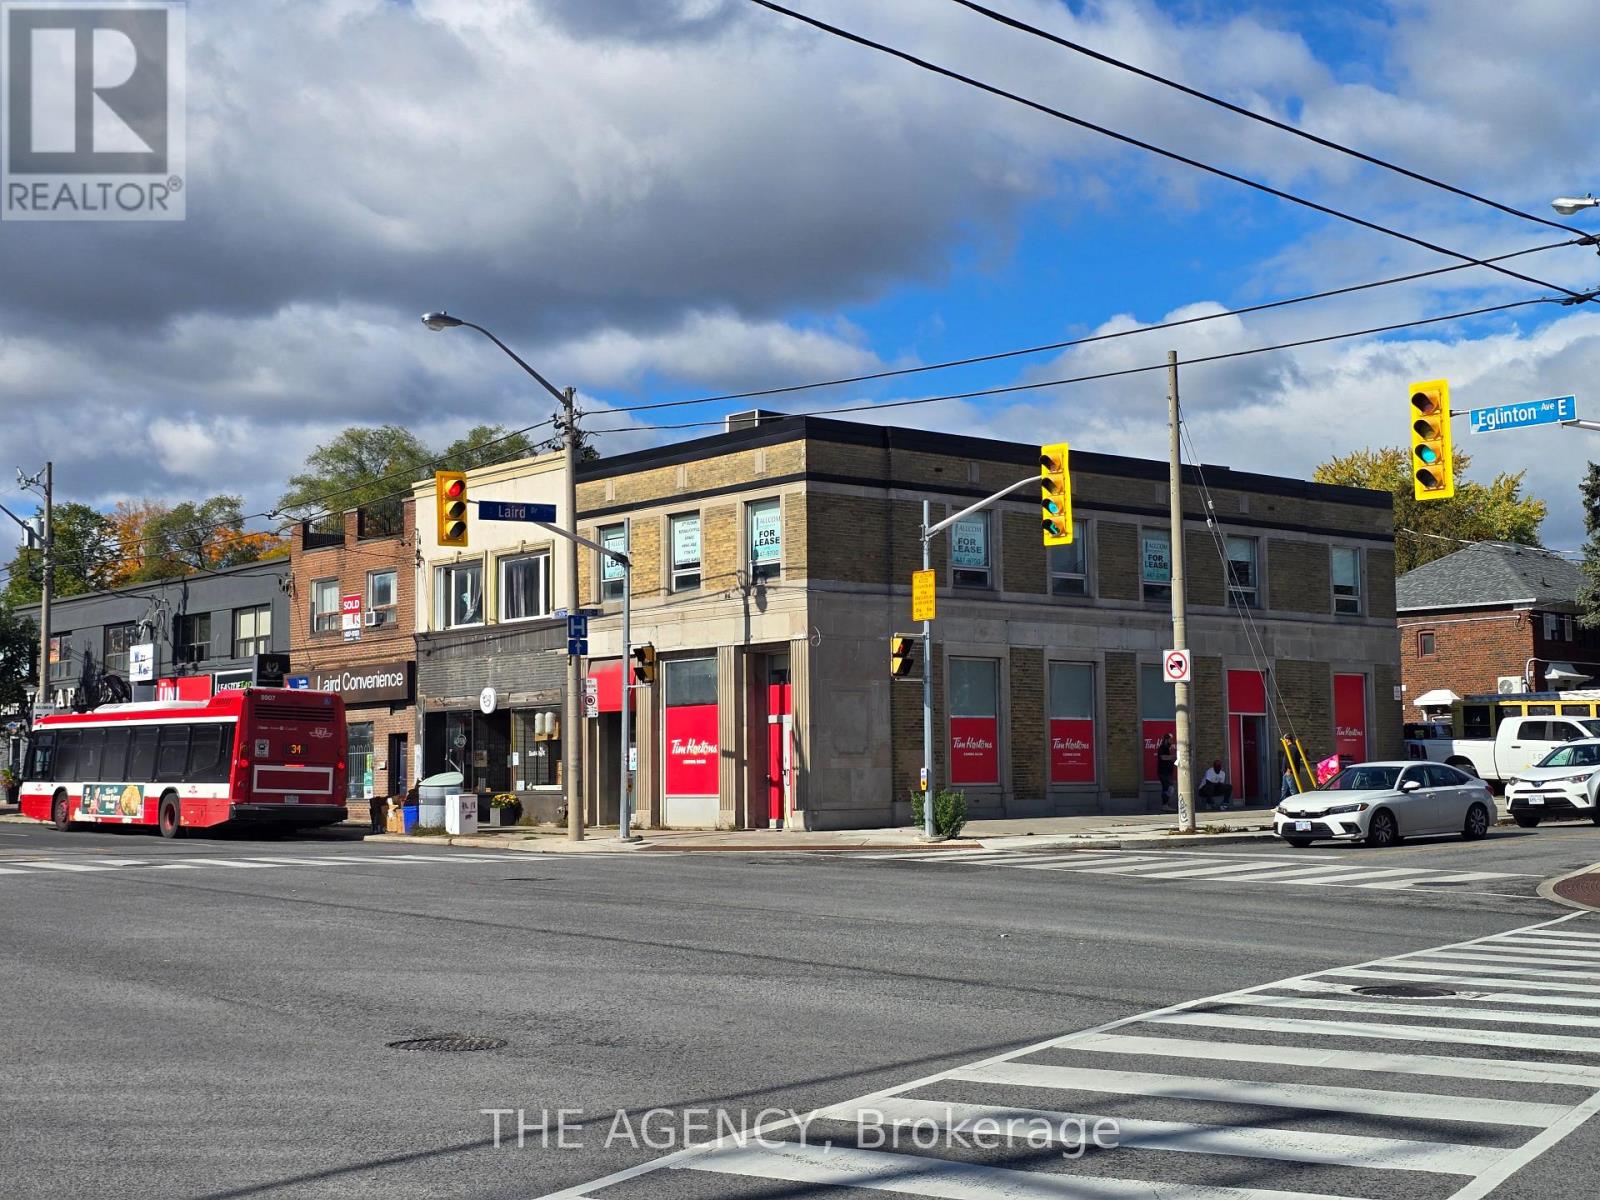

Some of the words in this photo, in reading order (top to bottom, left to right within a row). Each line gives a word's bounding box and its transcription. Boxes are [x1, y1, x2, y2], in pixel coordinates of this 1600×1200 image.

[1478, 407, 1537, 429] Eglinton
[1541, 402, 1555, 411] Ave
[1558, 399, 1567, 416] E
[498, 505, 526, 519] Laird
[759, 529, 775, 538] FOR
[755, 537, 780, 547] LEASE
[958, 538, 976, 546] FOR
[953, 545, 983, 554] LEASE
[1148, 554, 1163, 562] FOR
[1145, 561, 1168, 569] LEASE
[343, 600, 360, 610] SOLD
[570, 618, 585, 636] H
[317, 675, 341, 692] Laird
[342, 671, 404, 691] Convenience
[1336, 727, 1345, 736] Tim
[1345, 726, 1363, 736] Hortons
[671, 739, 687, 755] Tim
[687, 738, 718, 755] Hortons
[952, 737, 966, 749] Tim
[966, 736, 993, 749] Hortons
[1052, 738, 1065, 749] Tim
[1065, 737, 1090, 750] Hortons
[1144, 738, 1156, 749] Tim
[290, 744, 302, 754] 34
